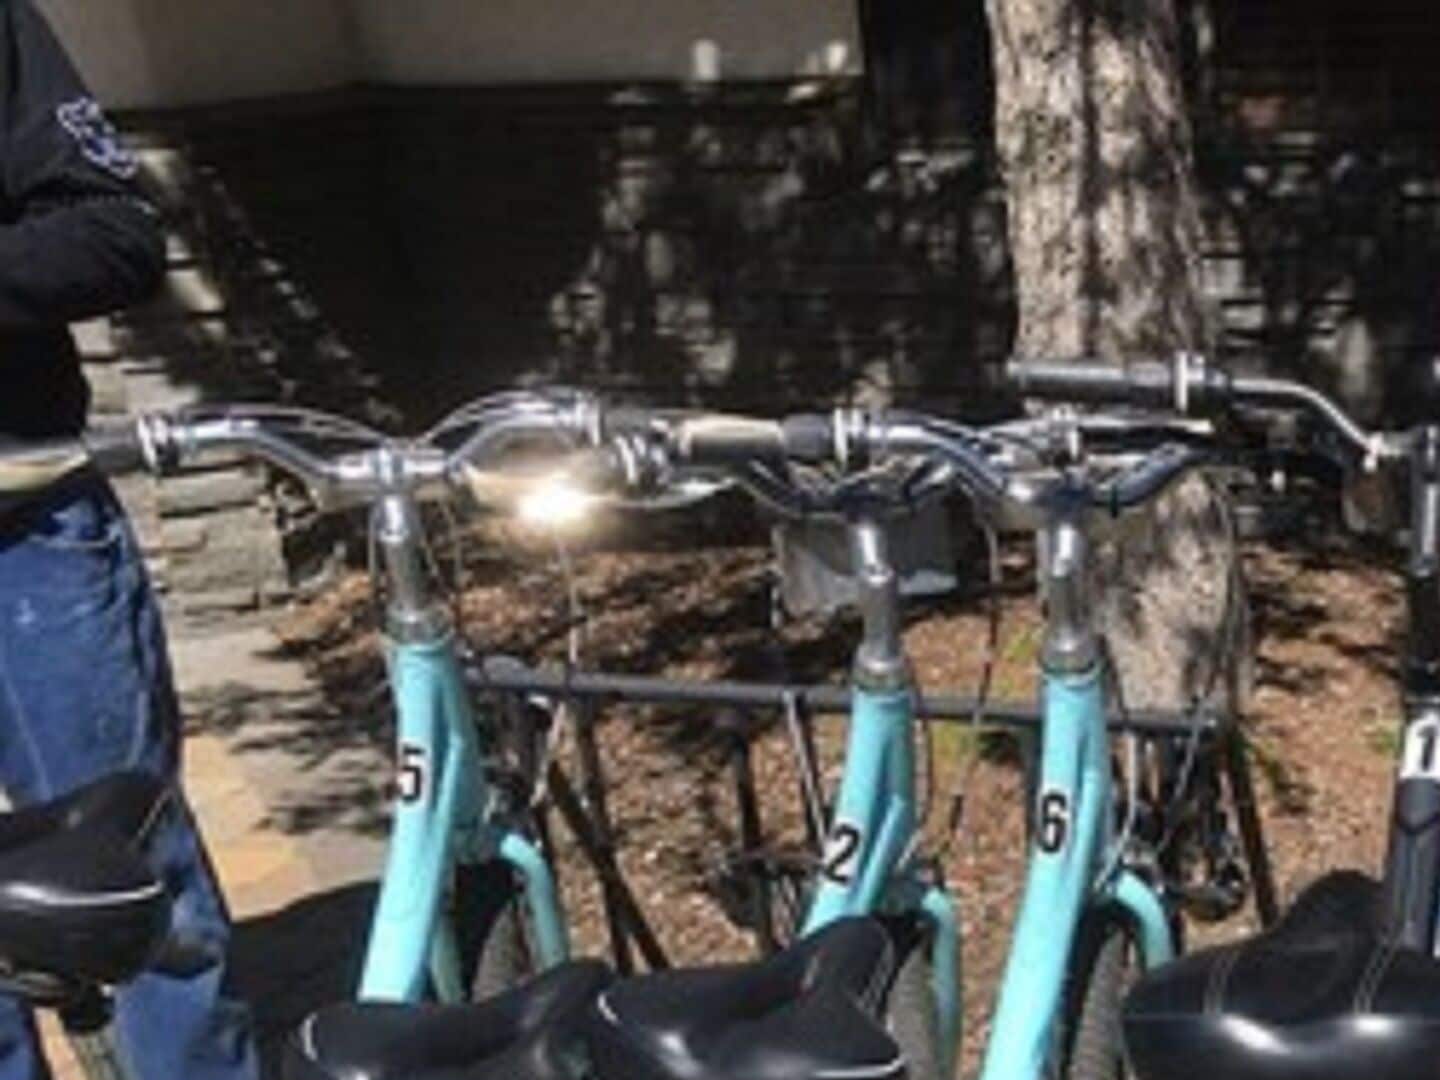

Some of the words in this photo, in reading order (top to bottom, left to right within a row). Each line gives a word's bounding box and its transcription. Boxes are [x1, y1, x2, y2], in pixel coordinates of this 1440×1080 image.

[400, 744, 423, 804] 5
[1416, 723, 1438, 772] 1
[1038, 789, 1068, 853] 6
[824, 824, 860, 883] 2
